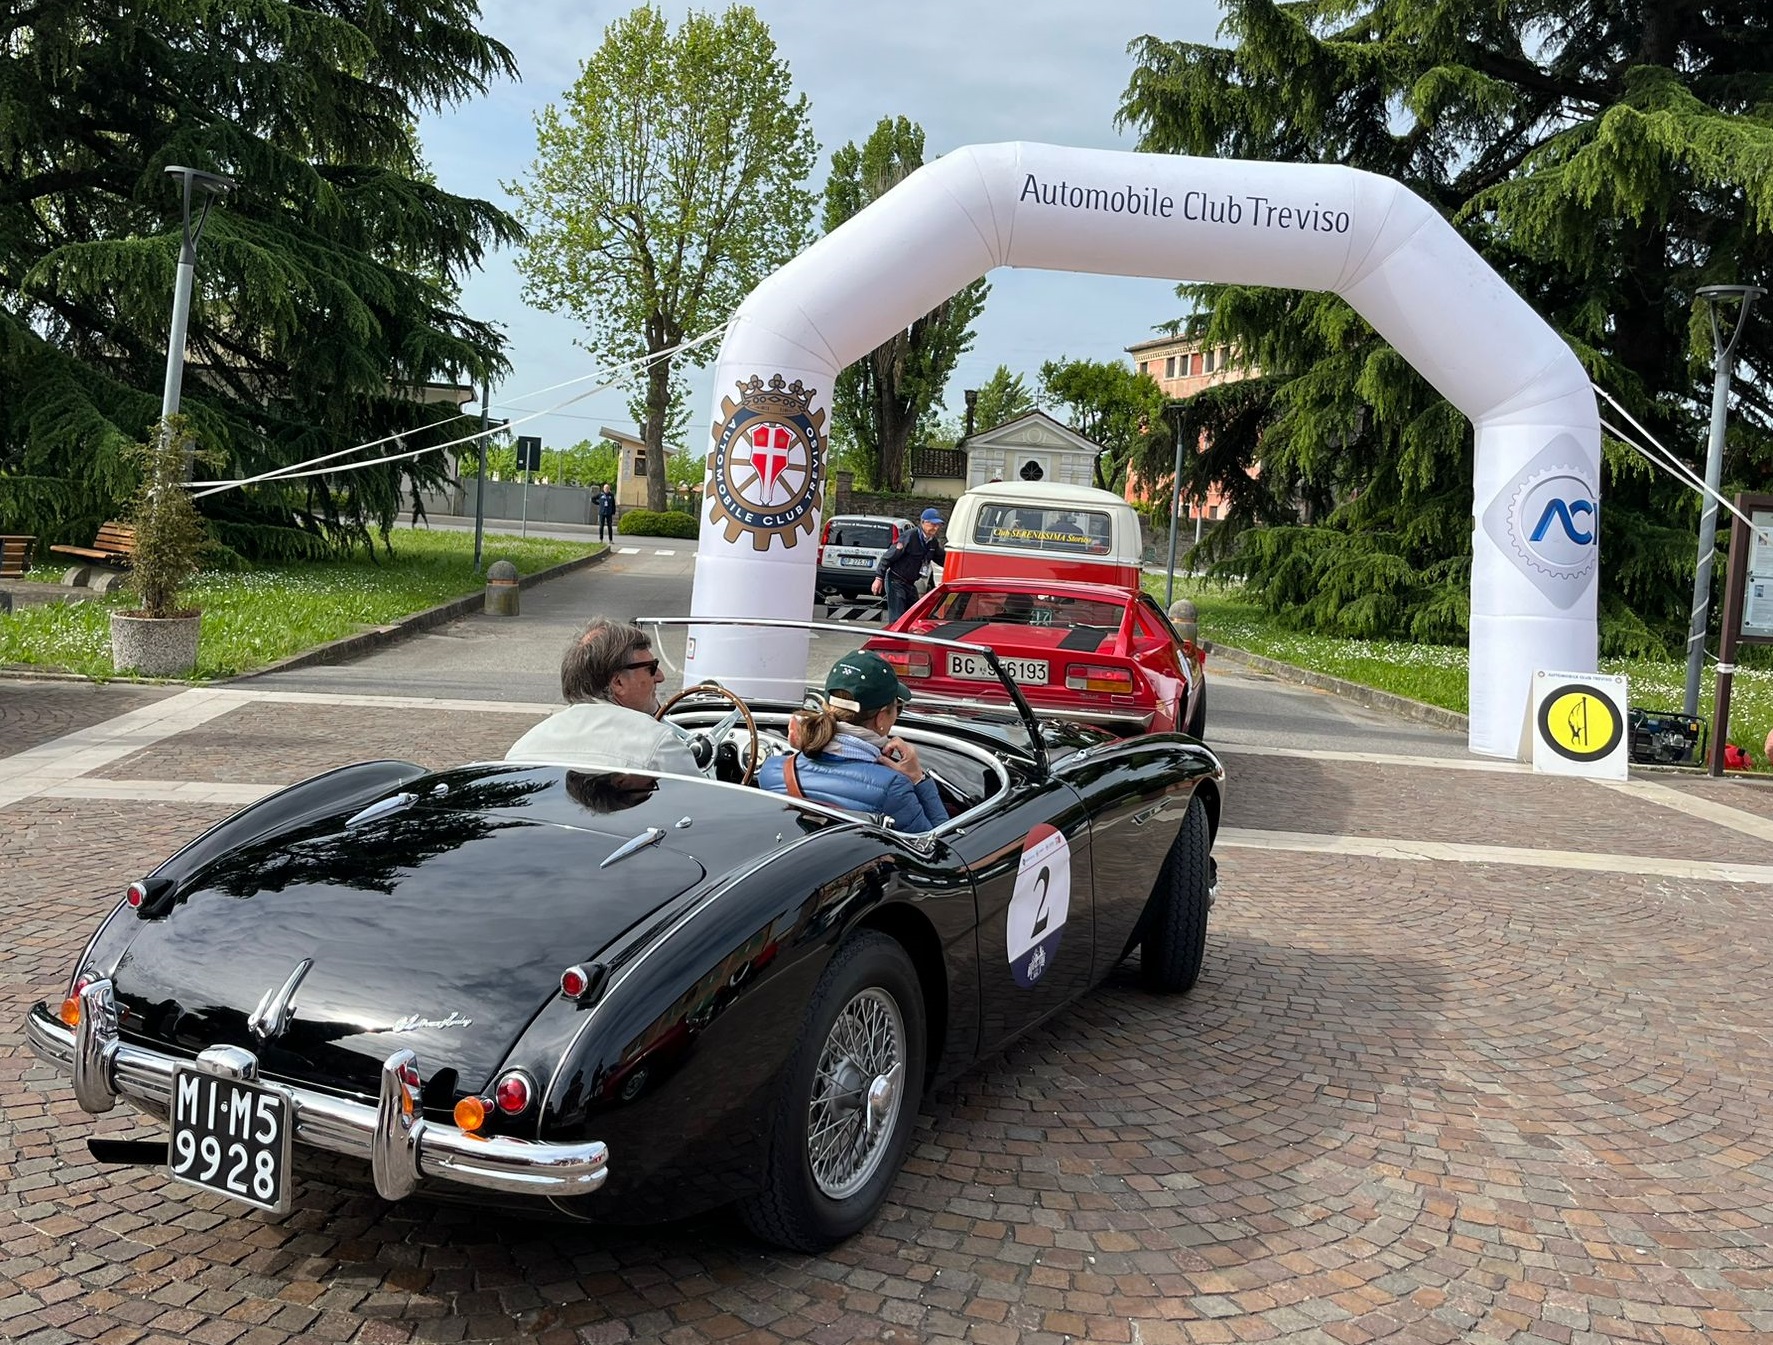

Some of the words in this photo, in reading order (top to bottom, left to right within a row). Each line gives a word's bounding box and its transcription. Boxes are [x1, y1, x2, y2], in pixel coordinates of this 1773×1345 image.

[1019, 173, 1174, 218] Automobile
[1183, 191, 1243, 225] Club
[1246, 196, 1351, 234] Treviso
[716, 418, 754, 523] AUTOMOBILE
[762, 505, 804, 526] CLUB
[804, 426, 819, 501] TREVISO
[993, 527, 1011, 538] Club
[1011, 528, 1066, 542] SERENISSIMA
[952, 656, 975, 675] BG
[987, 661, 1047, 680] 96193
[1030, 865, 1051, 940] 2
[174, 1129, 275, 1199] 9928
